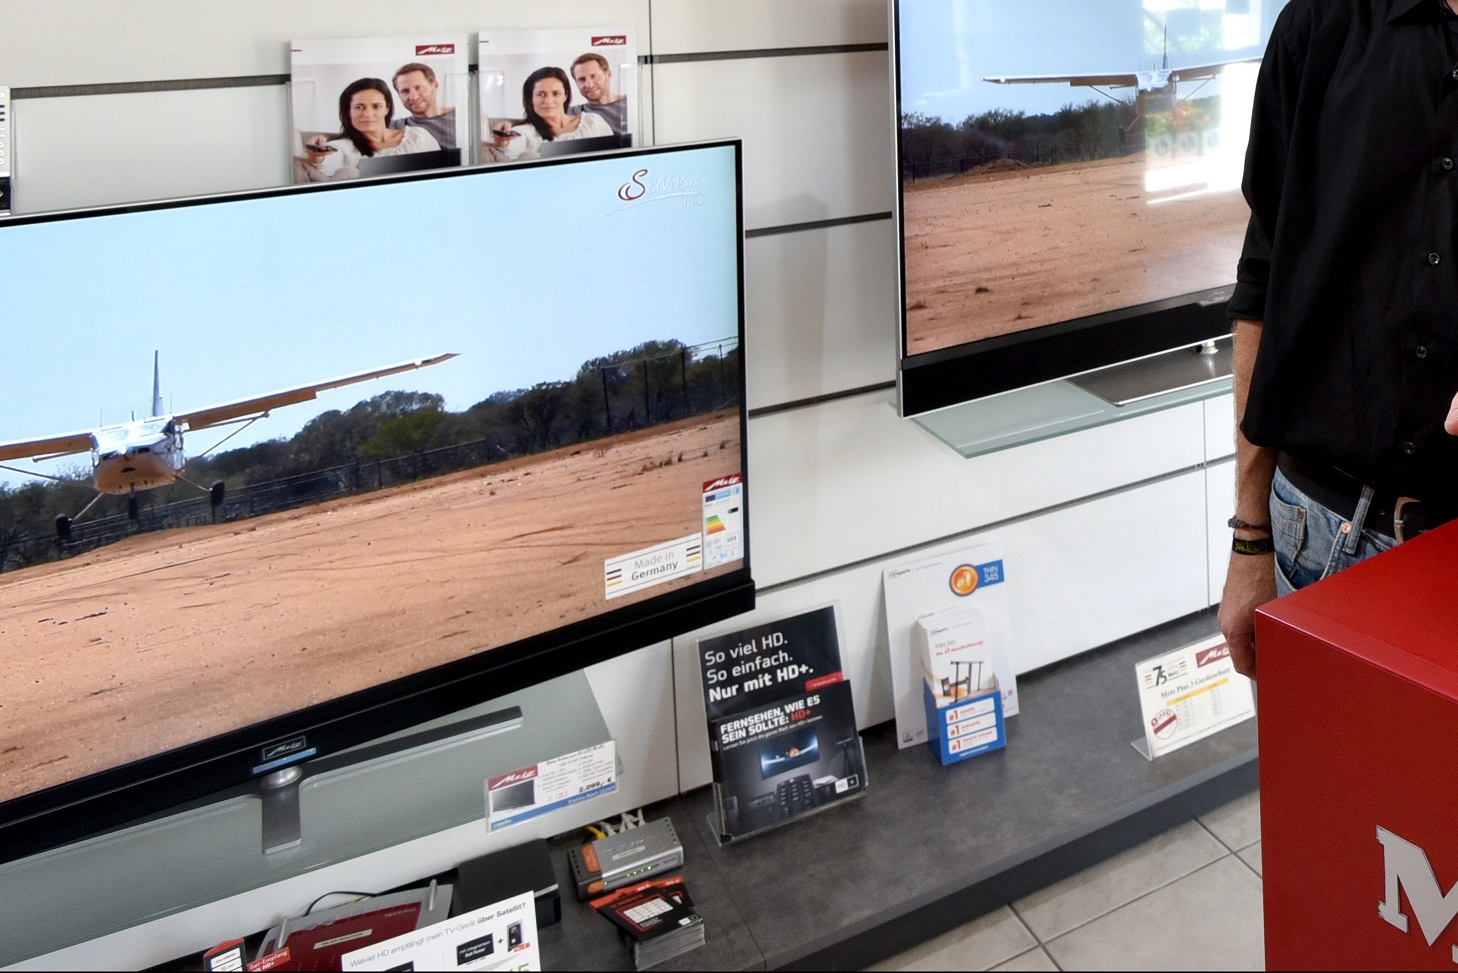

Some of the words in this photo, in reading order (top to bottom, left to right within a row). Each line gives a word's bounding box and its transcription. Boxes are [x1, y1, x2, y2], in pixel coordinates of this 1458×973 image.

[418, 45, 453, 54] Metz
[594, 36, 625, 46] Metz
[705, 476, 740, 492] Metz
[634, 554, 662, 570] Made
[665, 550, 675, 560] in
[631, 561, 679, 582] Germany
[704, 650, 726, 666] So
[729, 639, 758, 659] viel
[761, 632, 788, 650] HD.
[706, 669, 728, 684] So
[732, 650, 794, 677] einfach.
[1152, 665, 1167, 687] 75
[708, 684, 739, 703] Nur
[744, 673, 773, 692] mit
[776, 664, 814, 683] HD+.
[720, 707, 784, 735] FERNSEHEN,
[784, 699, 805, 714] WIE
[806, 694, 821, 707] ES
[721, 728, 747, 744] SEIN
[748, 716, 790, 736] SOLLTE:
[790, 710, 812, 722] HD+
[491, 769, 537, 789] Metz
[350, 953, 376, 968] Wieviel
[377, 948, 389, 960] HD
[391, 935, 425, 956] empfängt
[426, 932, 444, 943] mein
[477, 913, 495, 924] über
